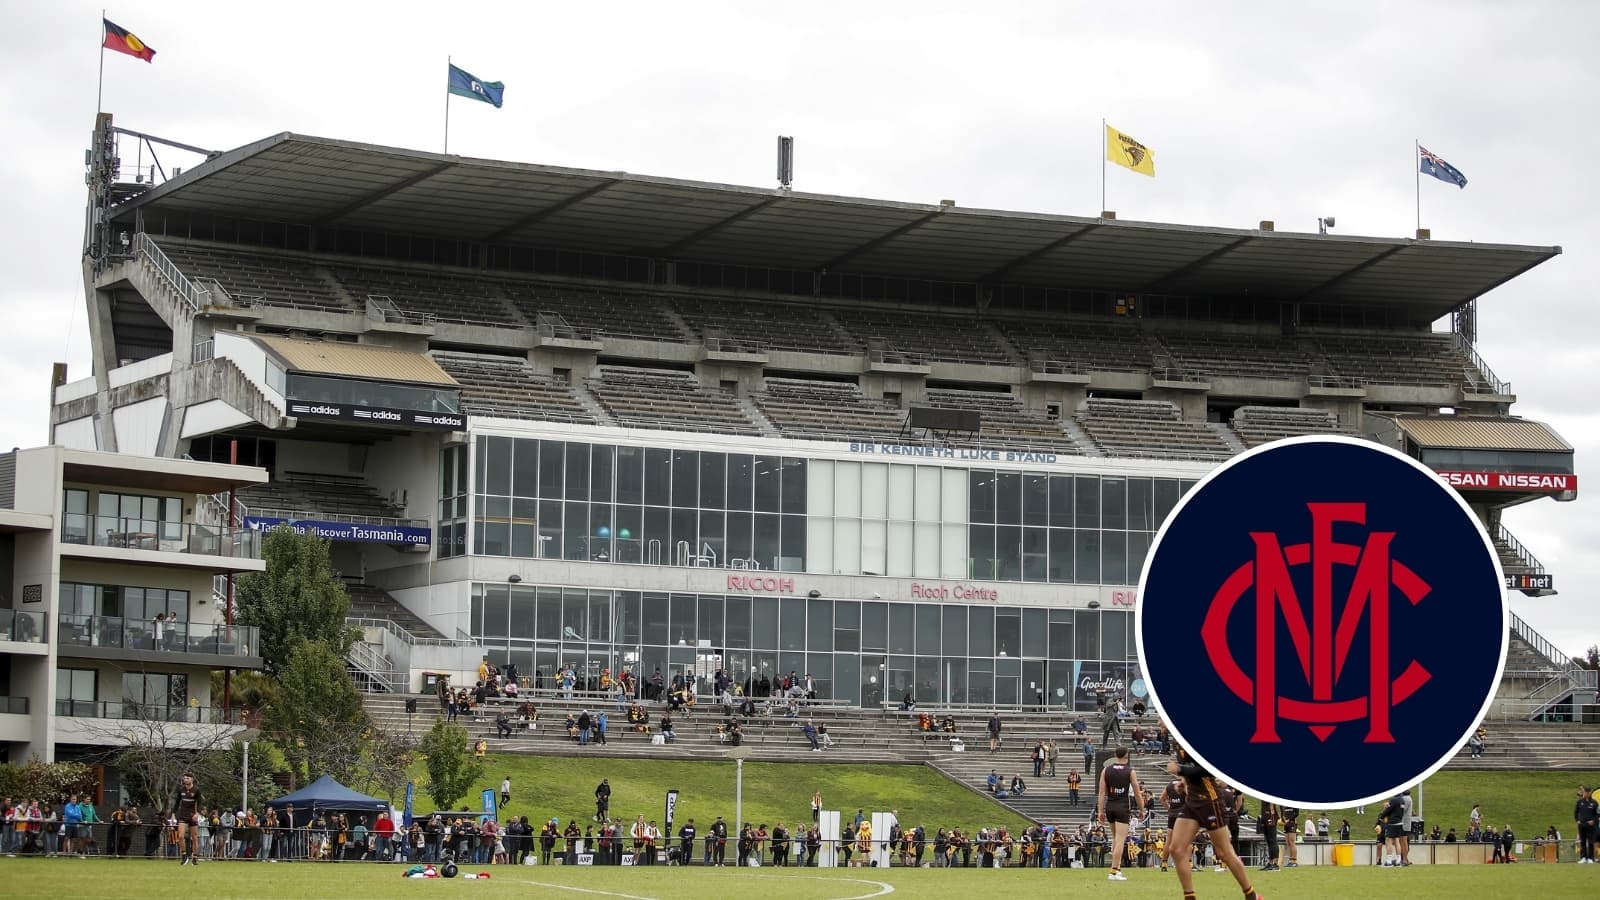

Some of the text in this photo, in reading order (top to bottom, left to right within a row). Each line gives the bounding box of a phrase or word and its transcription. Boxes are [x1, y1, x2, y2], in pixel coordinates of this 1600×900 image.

[310, 405, 340, 416] adidas
[372, 410, 401, 421] adidas
[433, 416, 462, 426] adidas
[850, 442, 1057, 464] SIR KENNETH LUKE STAND
[1439, 473, 1488, 486] SSAN
[1499, 475, 1567, 488] NISSAN
[260, 522, 305, 535] Tasnia
[727, 575, 794, 593] RICOH
[911, 582, 998, 601] Ricoh Centre
[579, 855, 592, 864] AXP
[623, 855, 633, 864] AX
